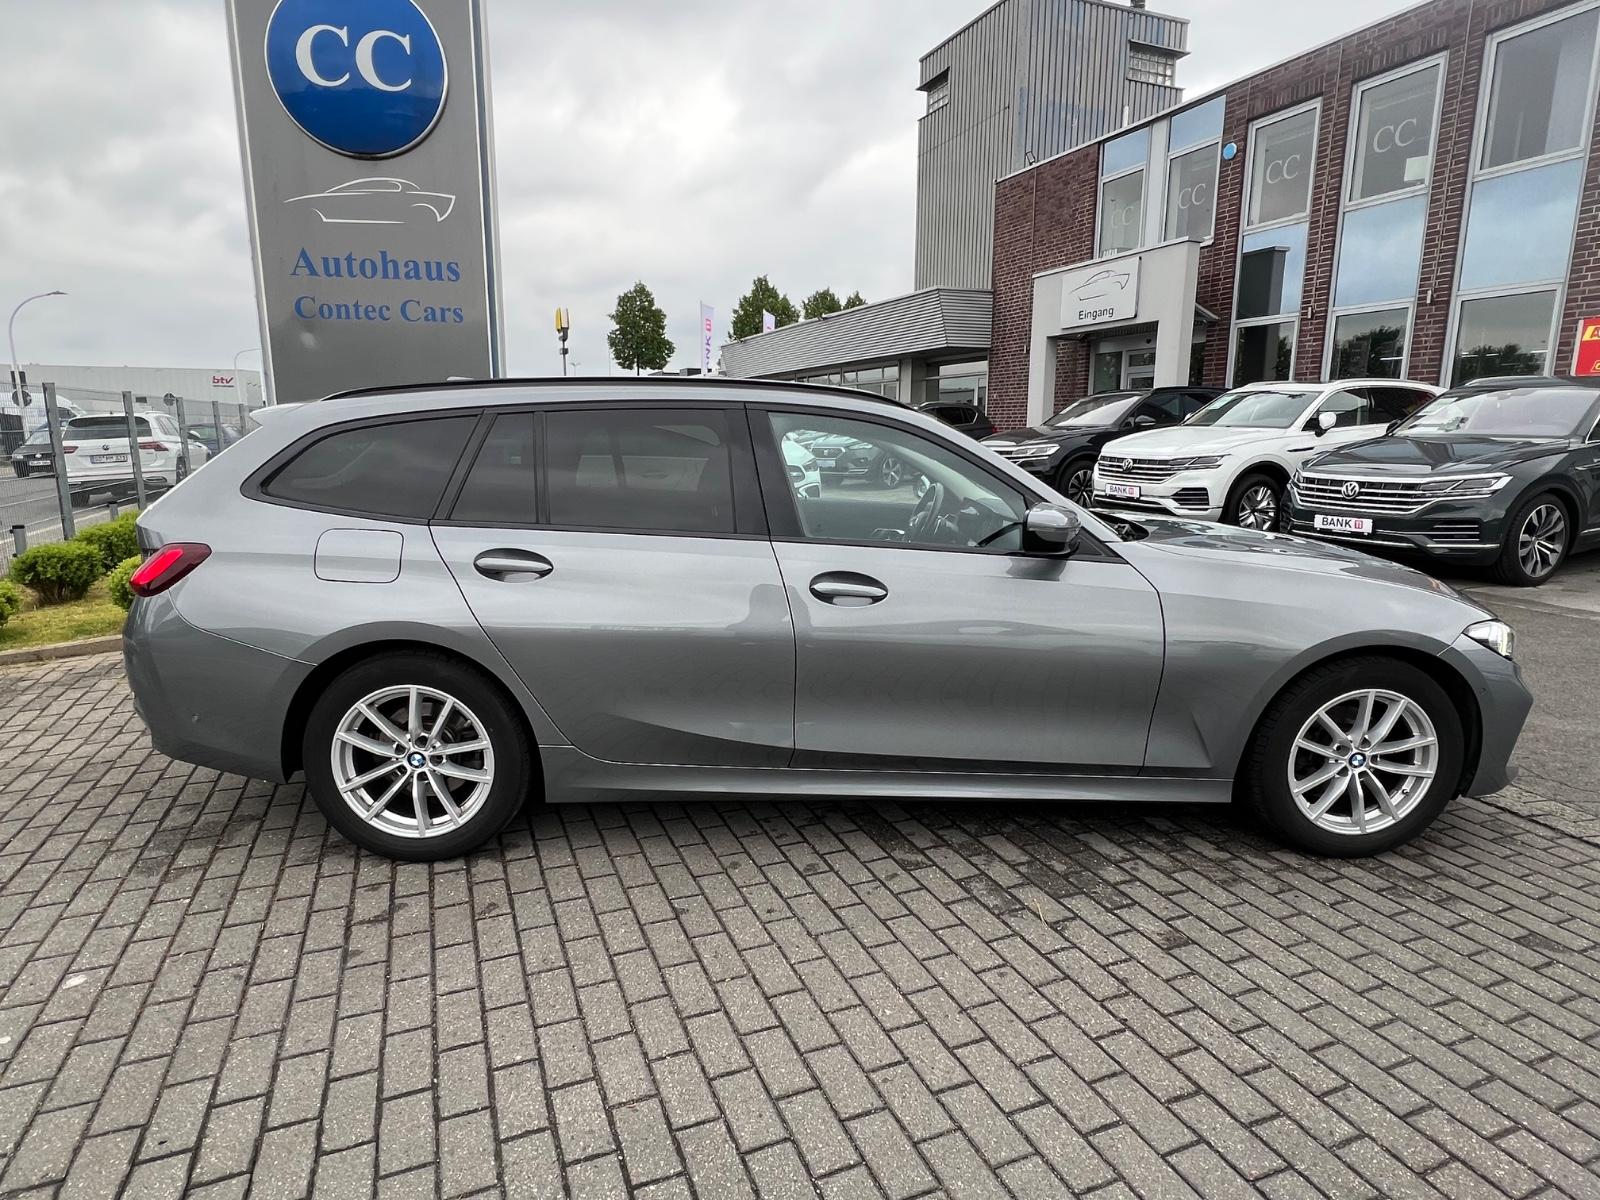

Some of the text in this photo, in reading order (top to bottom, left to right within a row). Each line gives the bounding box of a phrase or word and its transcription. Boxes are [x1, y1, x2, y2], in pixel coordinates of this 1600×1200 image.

[295, 24, 412, 92] CC
[1373, 118, 1417, 153] CC
[1266, 154, 1300, 184] CC
[1179, 183, 1206, 209] CC
[290, 247, 461, 282] Autohaus
[294, 295, 464, 323] Contec Cars
[1078, 307, 1114, 321] Eingang
[212, 375, 234, 384] btv
[1109, 485, 1128, 495] BANK
[1321, 517, 1352, 529] BANK
